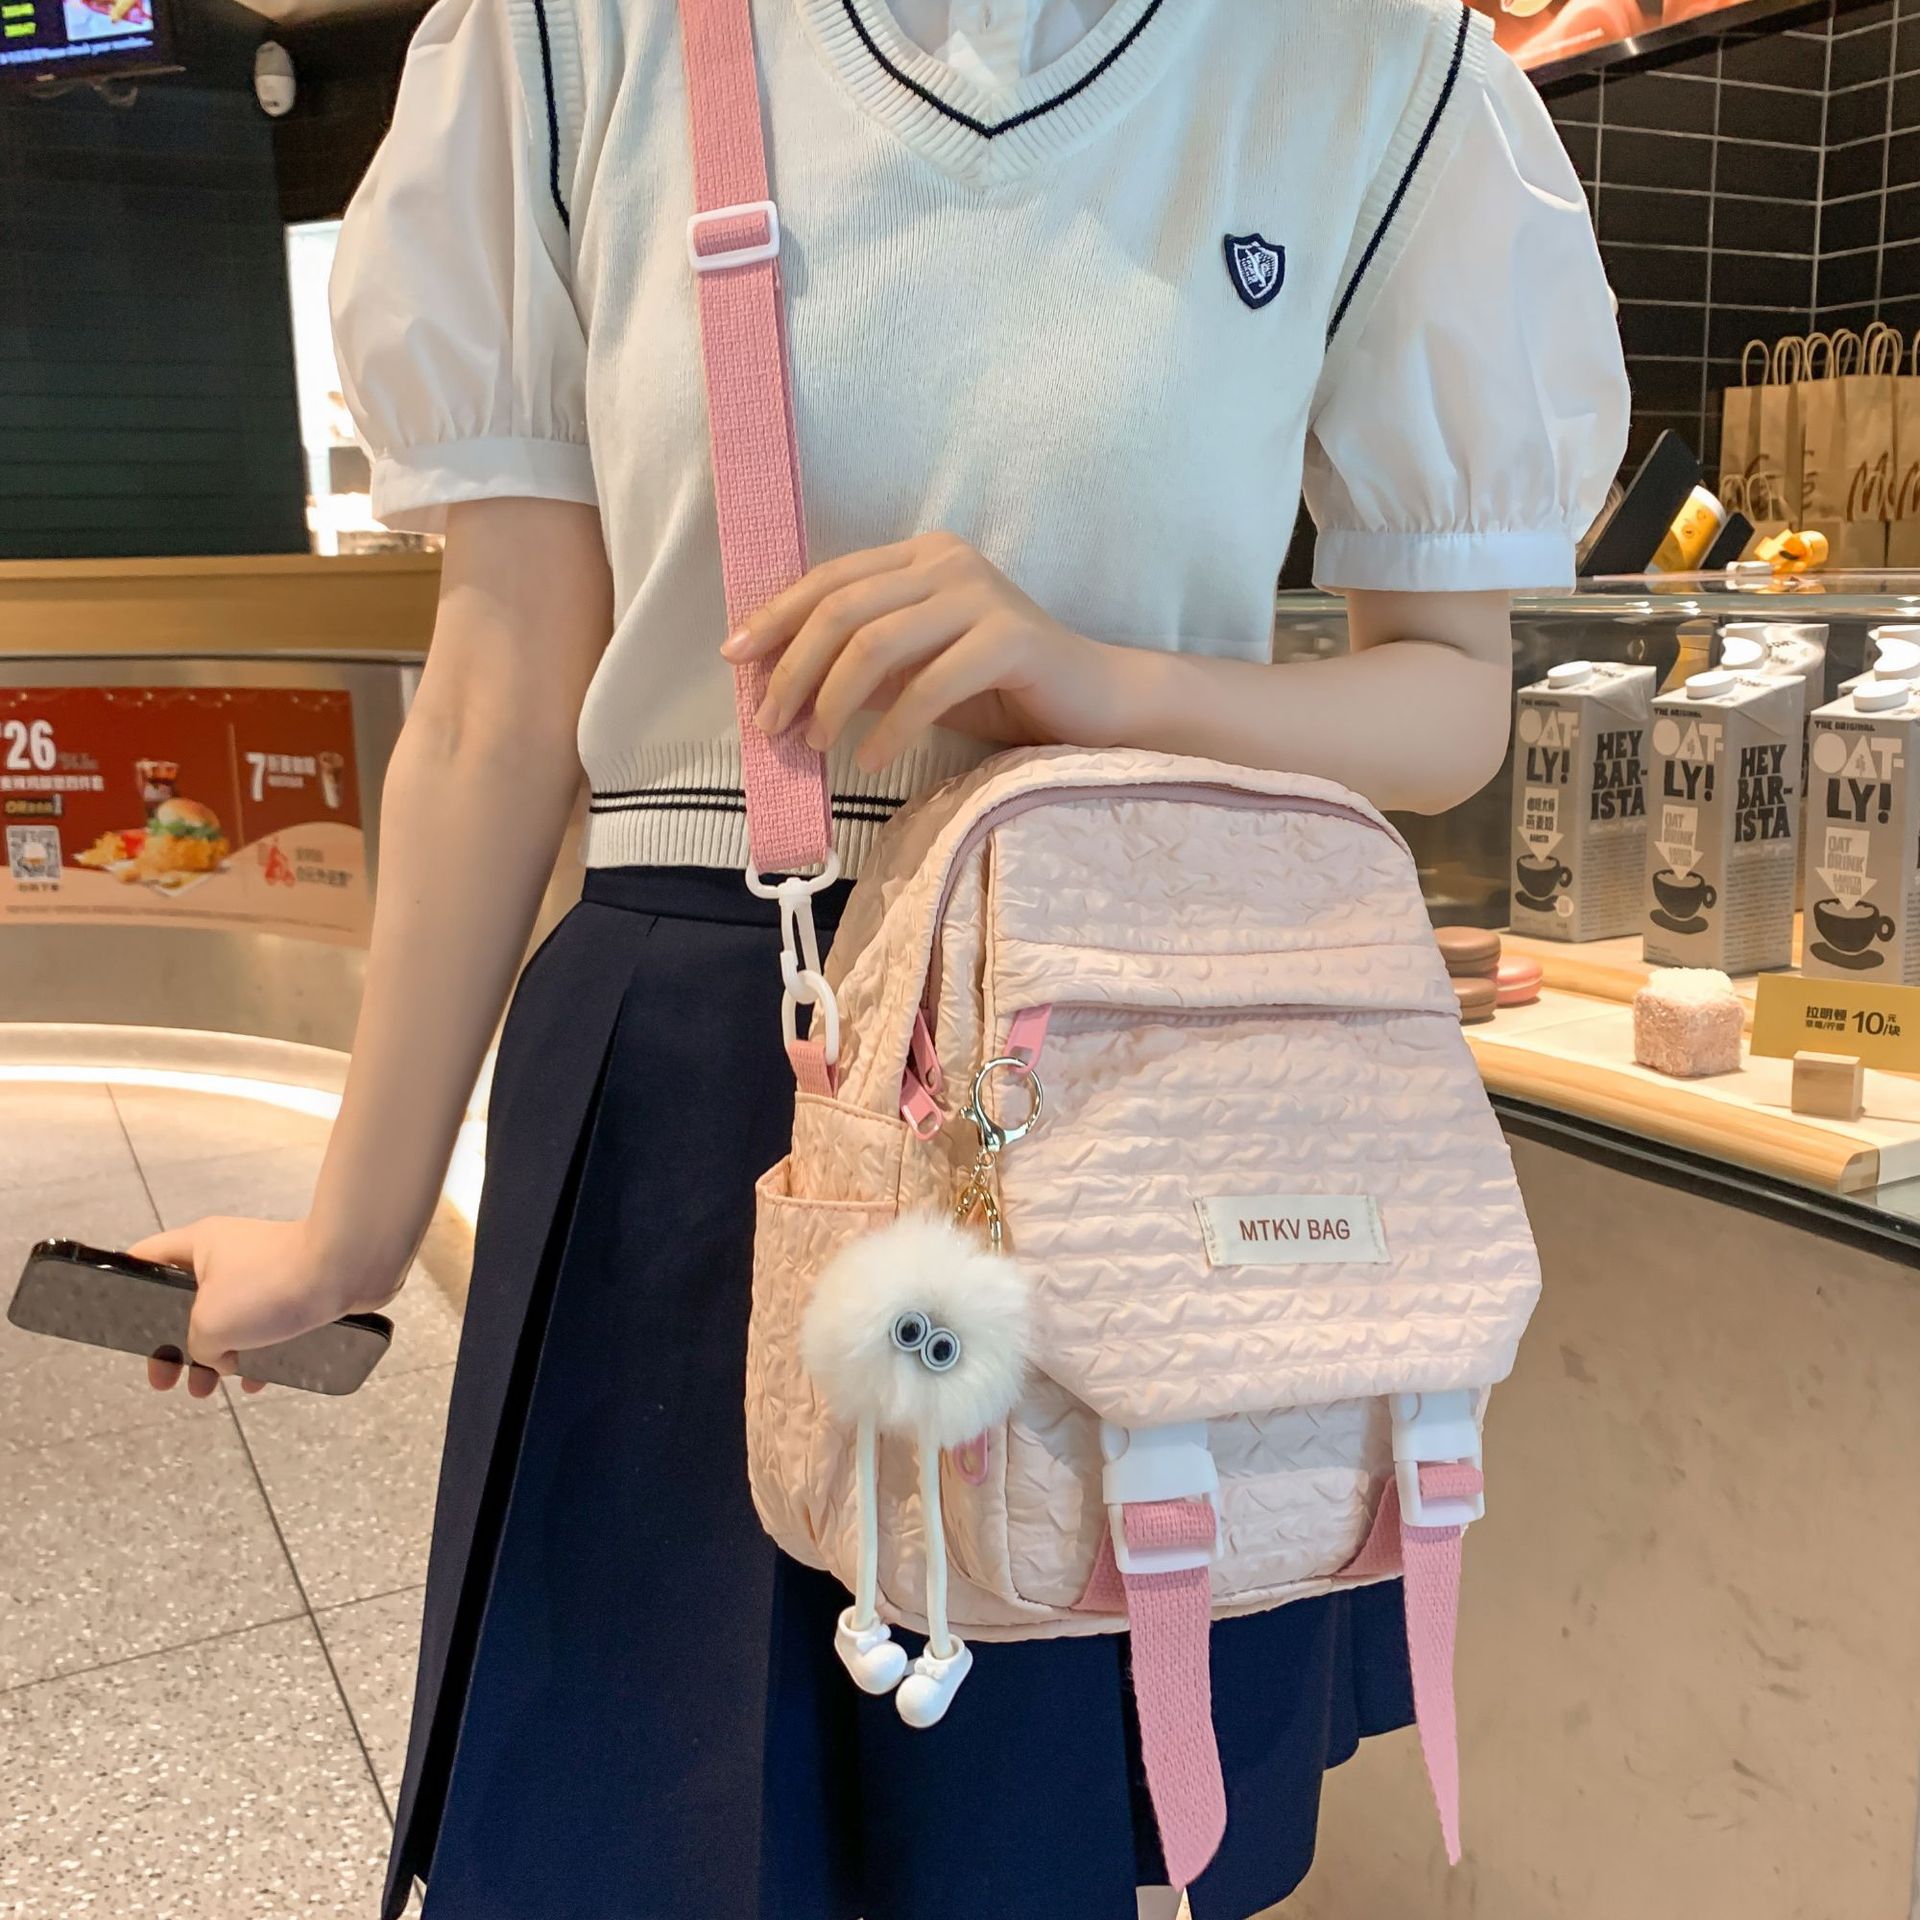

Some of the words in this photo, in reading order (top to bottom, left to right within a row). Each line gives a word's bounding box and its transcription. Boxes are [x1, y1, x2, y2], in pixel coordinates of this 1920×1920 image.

[1653, 718, 1724, 762] OAT-
[1814, 720, 1832, 730] THE
[1835, 722, 1875, 731] ORIGINAL
[1596, 730, 1643, 762] HEY
[1740, 744, 1787, 778] HEY
[1813, 732, 1905, 780] OAT-
[1526, 747, 1570, 784] LY!
[1593, 758, 1648, 790] BAR-
[1664, 760, 1714, 802] LY!
[1590, 786, 1646, 820] ISTA
[1736, 775, 1793, 810] BAR-
[1826, 778, 1891, 824] LY!
[1734, 806, 1790, 843] ISTA
[1828, 836, 1852, 853] OAT
[1827, 852, 1865, 873] DRINK
[1239, 1218, 1300, 1241] MTKV
[1307, 1218, 1350, 1241] BAG
